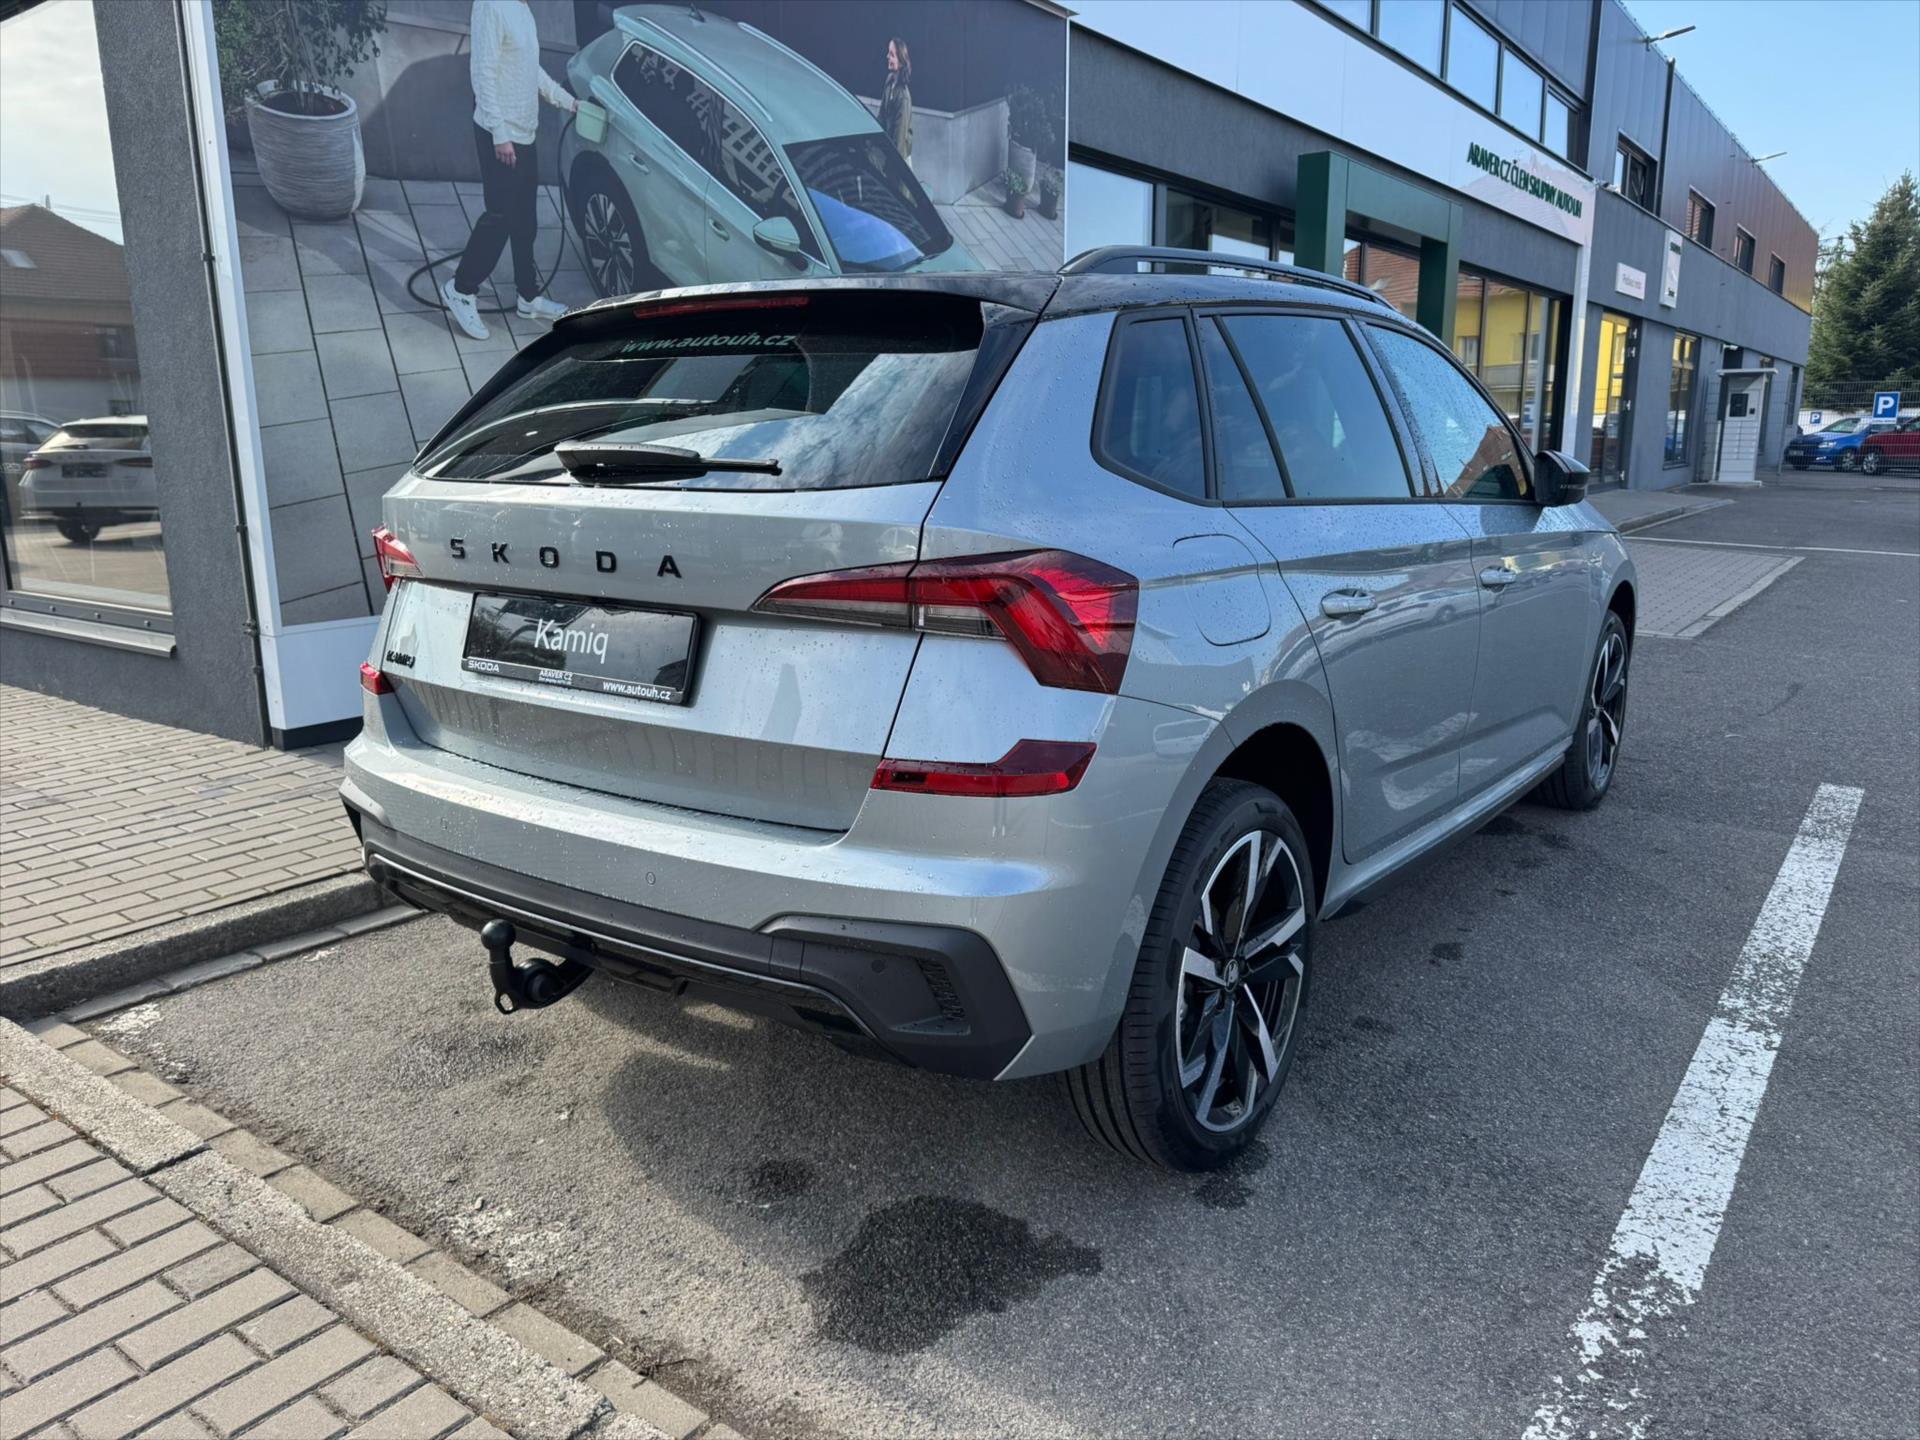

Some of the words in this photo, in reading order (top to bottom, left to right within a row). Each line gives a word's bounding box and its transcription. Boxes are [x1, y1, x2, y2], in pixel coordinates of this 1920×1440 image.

[1467, 142, 1500, 177] ARAVER
[1500, 159, 1511, 183] CZ
[1511, 159, 1530, 192] ČLEN
[1529, 175, 1557, 206] SKUPINY
[620, 331, 796, 353] www.autouh.cz
[1877, 396, 1895, 415] P
[450, 538, 682, 578] SKODA
[534, 618, 609, 665] Kamiq
[602, 680, 672, 700] www.autouh.cz
